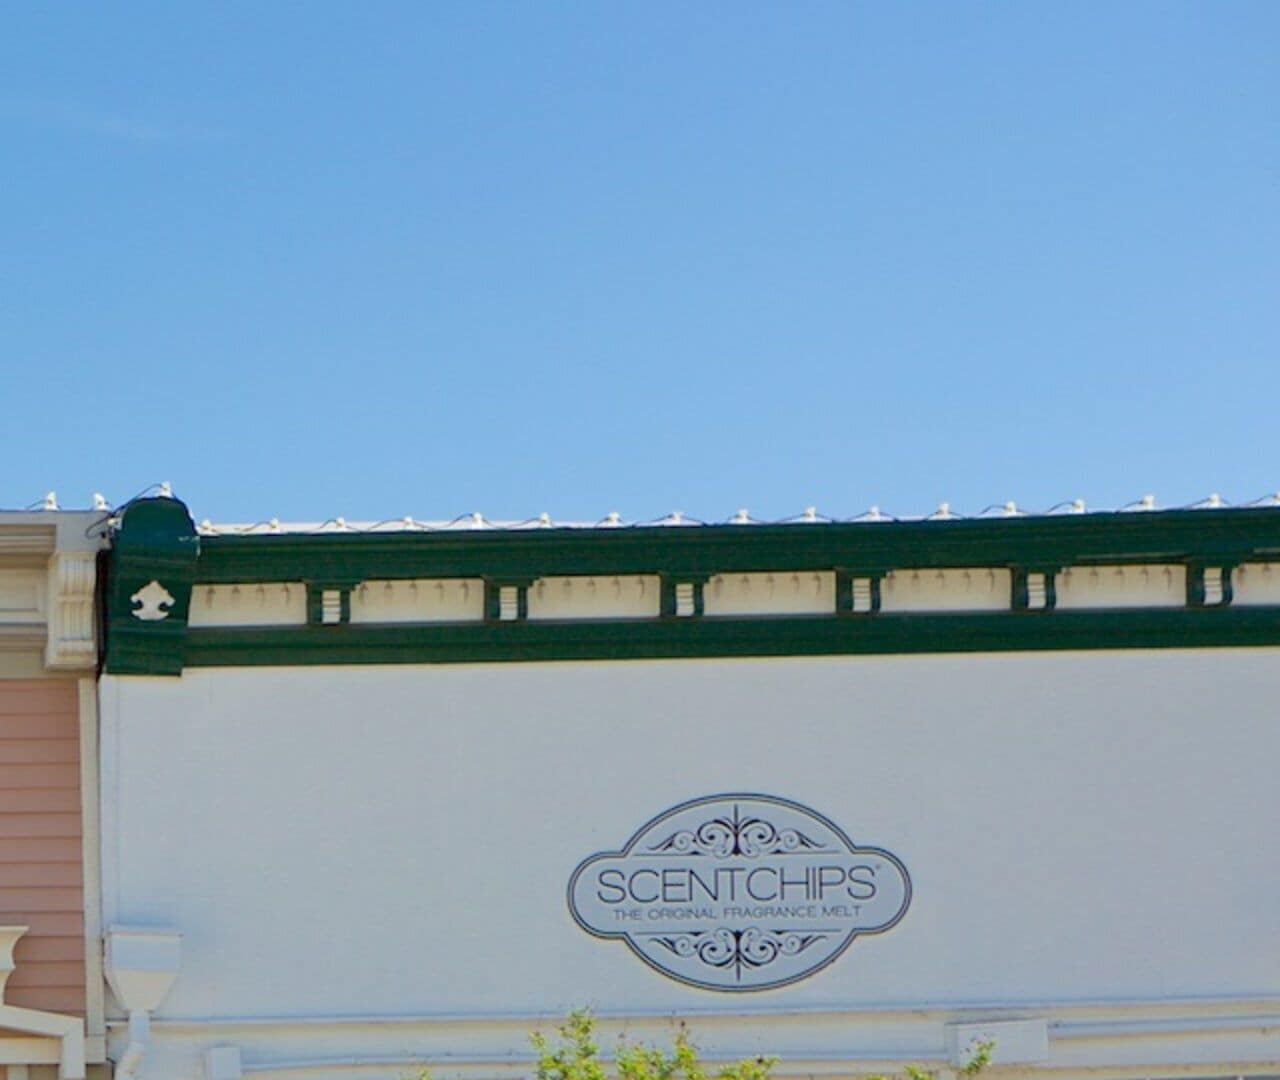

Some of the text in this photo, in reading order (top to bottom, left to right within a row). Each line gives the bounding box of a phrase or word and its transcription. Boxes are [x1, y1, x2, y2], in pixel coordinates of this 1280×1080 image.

[596, 864, 878, 904] SCENTCHIPS
[613, 904, 863, 921] THE ORIGINAL FRAGRANCE MELT
